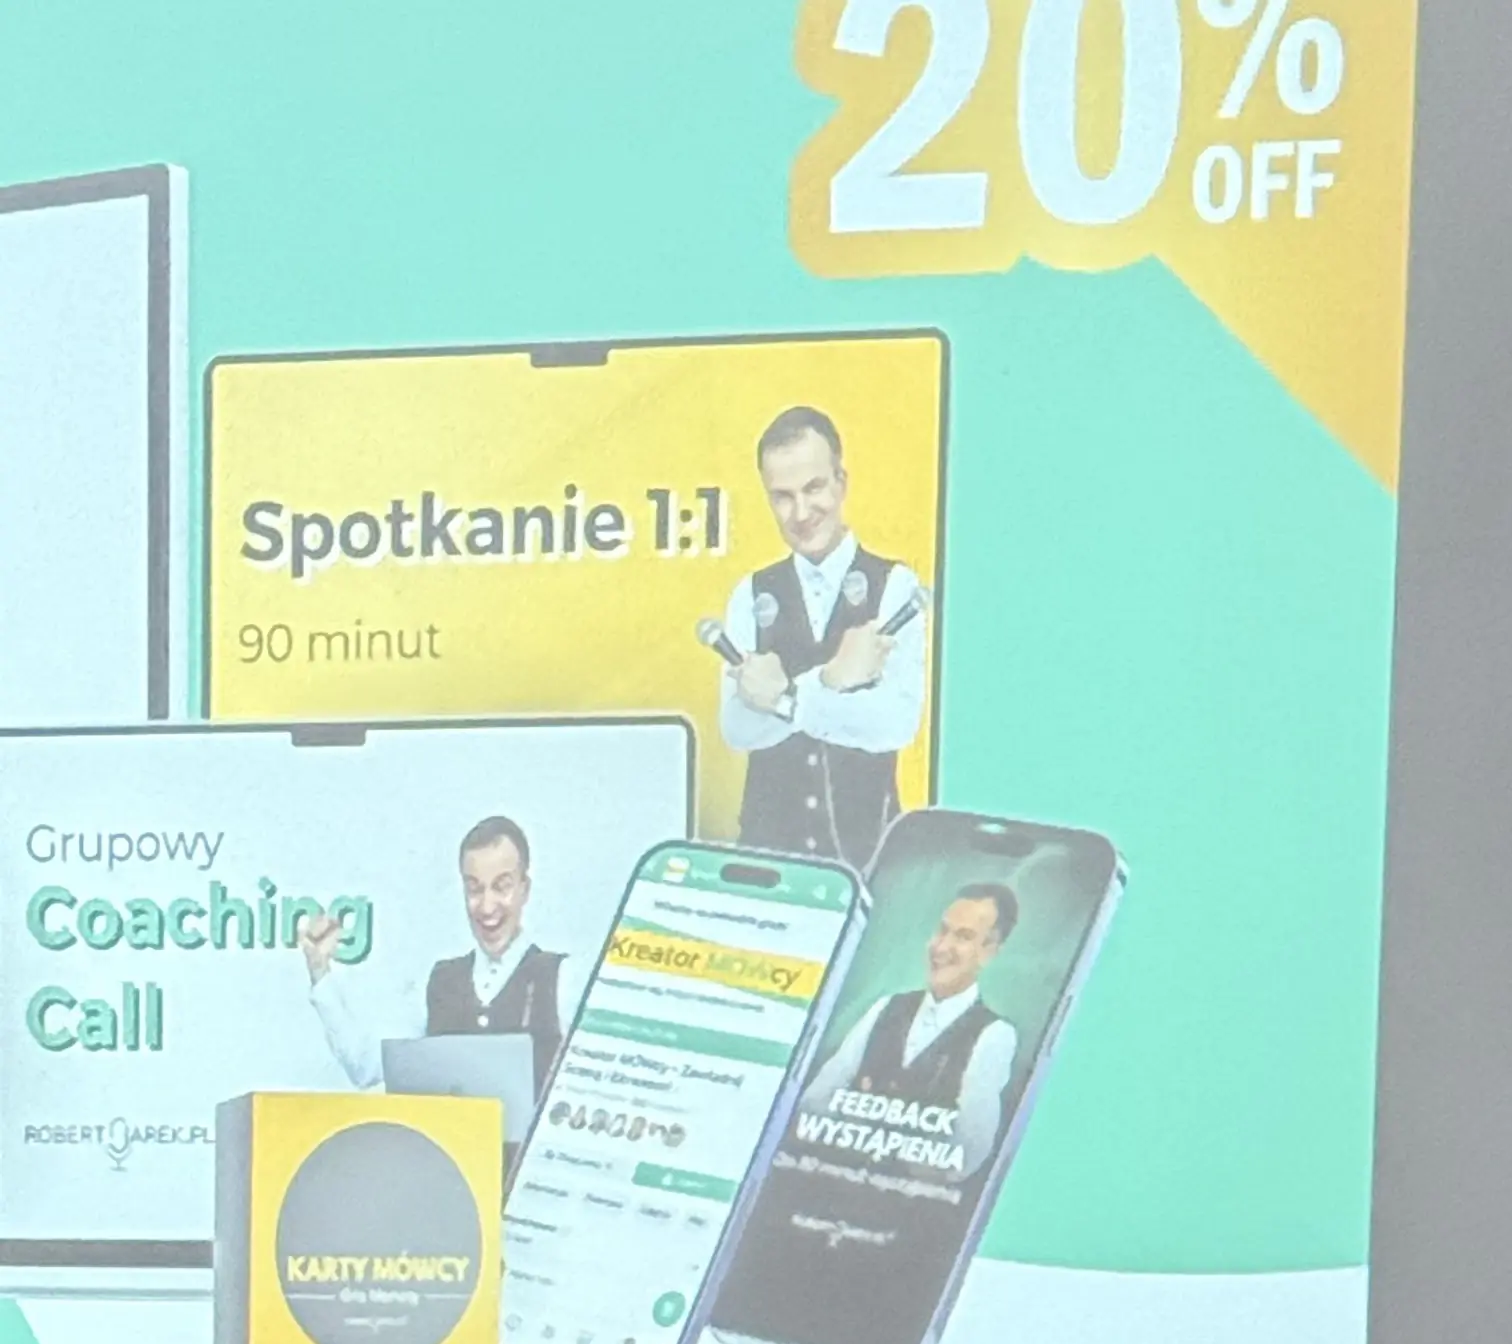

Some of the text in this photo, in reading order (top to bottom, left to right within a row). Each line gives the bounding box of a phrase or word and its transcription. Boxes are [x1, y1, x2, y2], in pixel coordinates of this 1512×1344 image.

[1191, 139, 1342, 224] OFF
[239, 484, 726, 580] Spotkanie 1:1
[238, 619, 441, 664] 90 minut
[25, 824, 225, 871] Grupowy
[25, 876, 375, 965] Coaching
[611, 936, 702, 970] Kreator
[25, 980, 165, 1052] Call
[828, 1087, 960, 1136] FEEDBACK
[796, 1112, 965, 1173] WYSTĄPIENIA
[287, 1249, 470, 1282] KARTY MÓWCY
